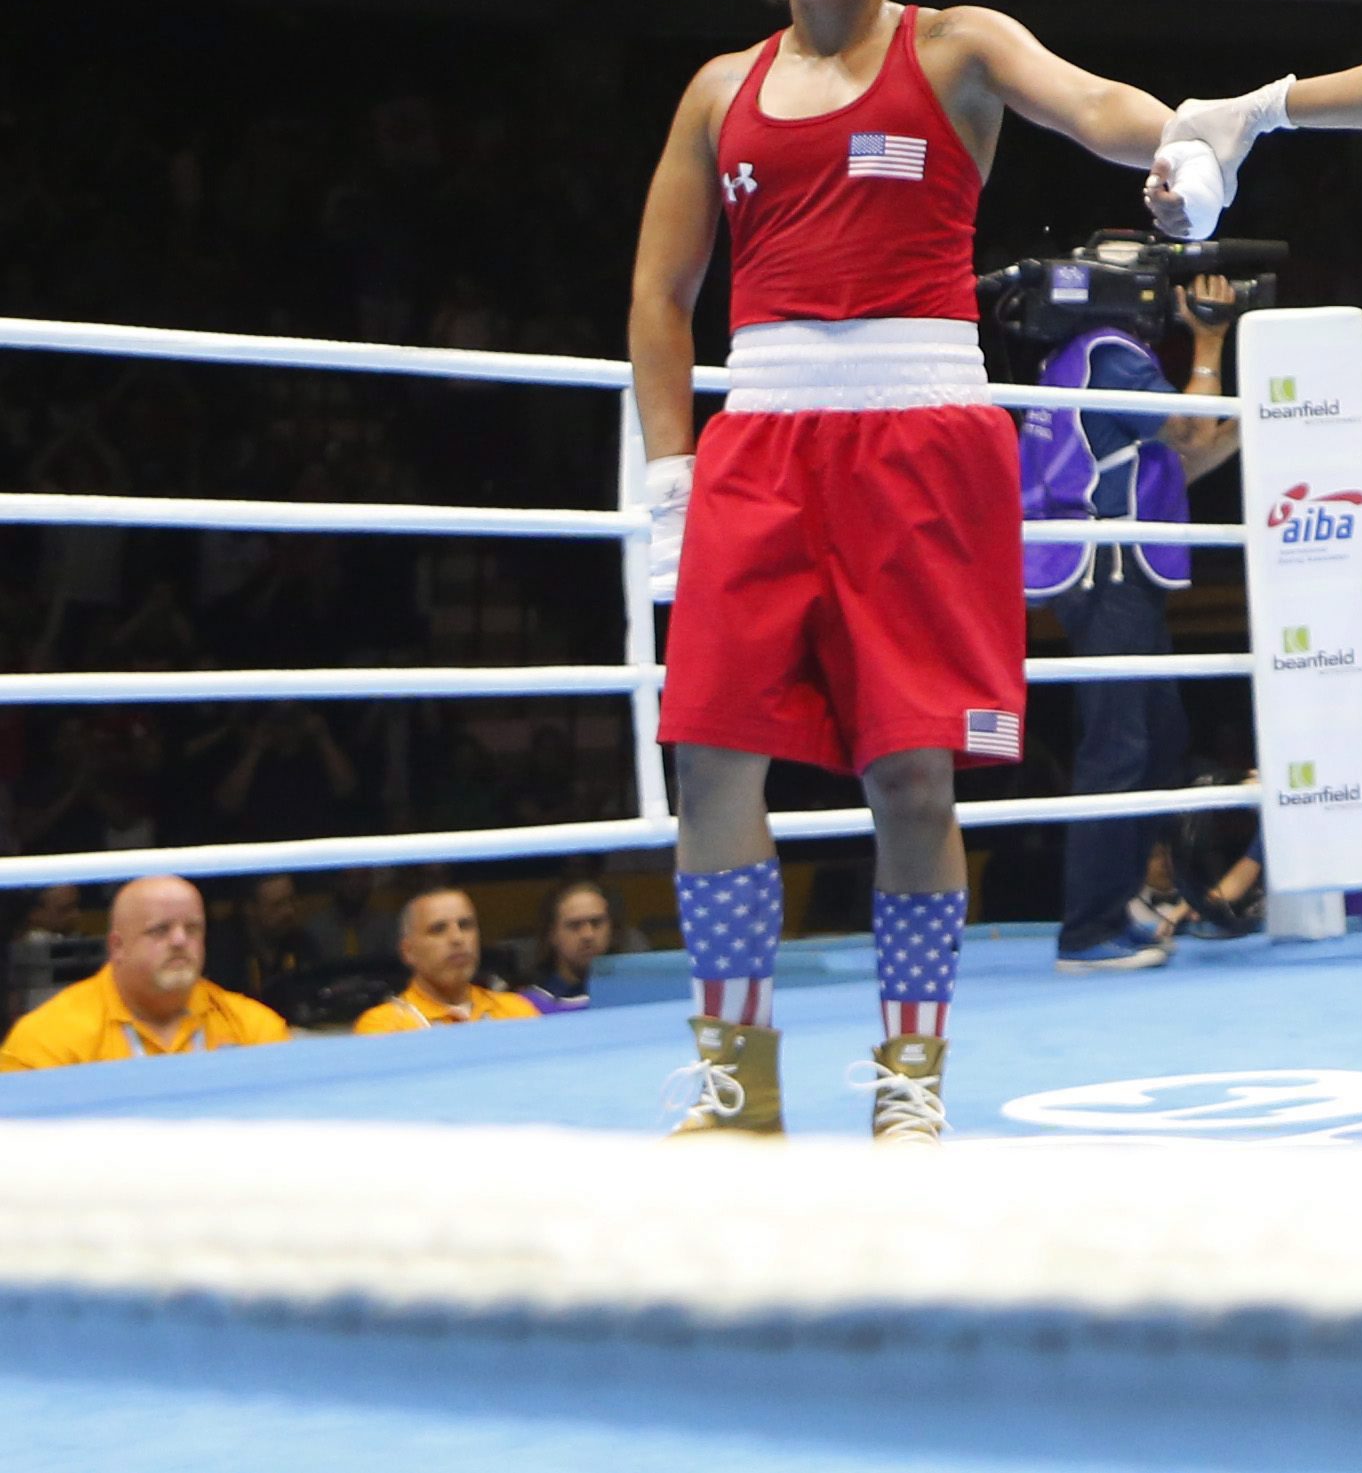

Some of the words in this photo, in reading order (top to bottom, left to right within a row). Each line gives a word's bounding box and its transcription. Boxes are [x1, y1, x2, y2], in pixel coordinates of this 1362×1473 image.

[1259, 399, 1340, 420] beanfield
[1282, 506, 1355, 543] aiba
[1273, 648, 1355, 671] beanfield
[1279, 783, 1361, 806] beanfield
